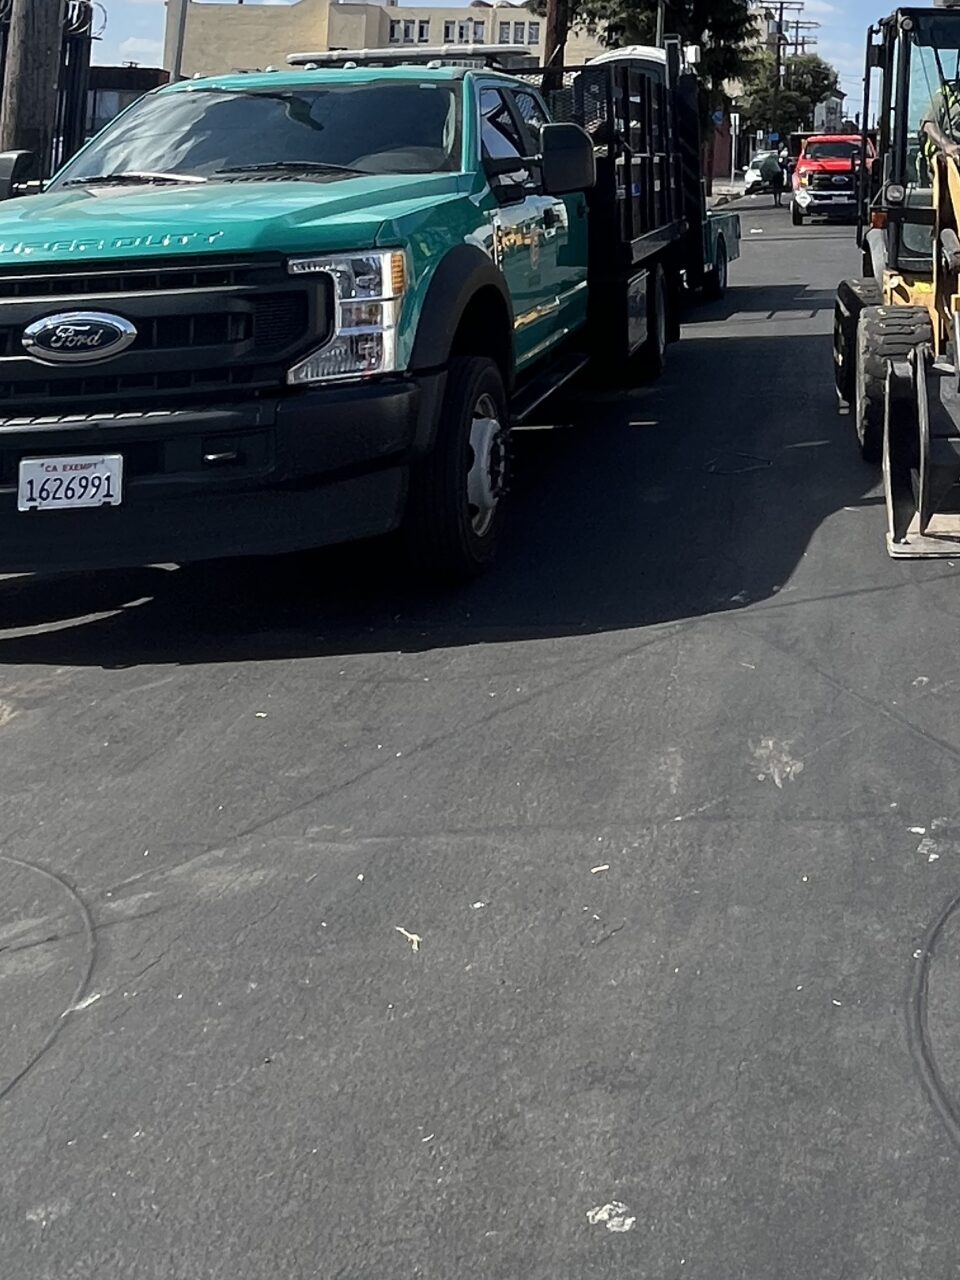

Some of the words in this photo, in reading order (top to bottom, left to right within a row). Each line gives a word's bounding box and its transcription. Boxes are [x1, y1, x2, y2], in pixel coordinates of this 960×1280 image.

[0, 236, 104, 254] UPER
[111, 231, 224, 248] DUTY
[50, 325, 104, 348] Ford
[45, 464, 58, 473] CA
[62, 462, 98, 473] EXEMPT
[26, 475, 114, 502] 1626991
